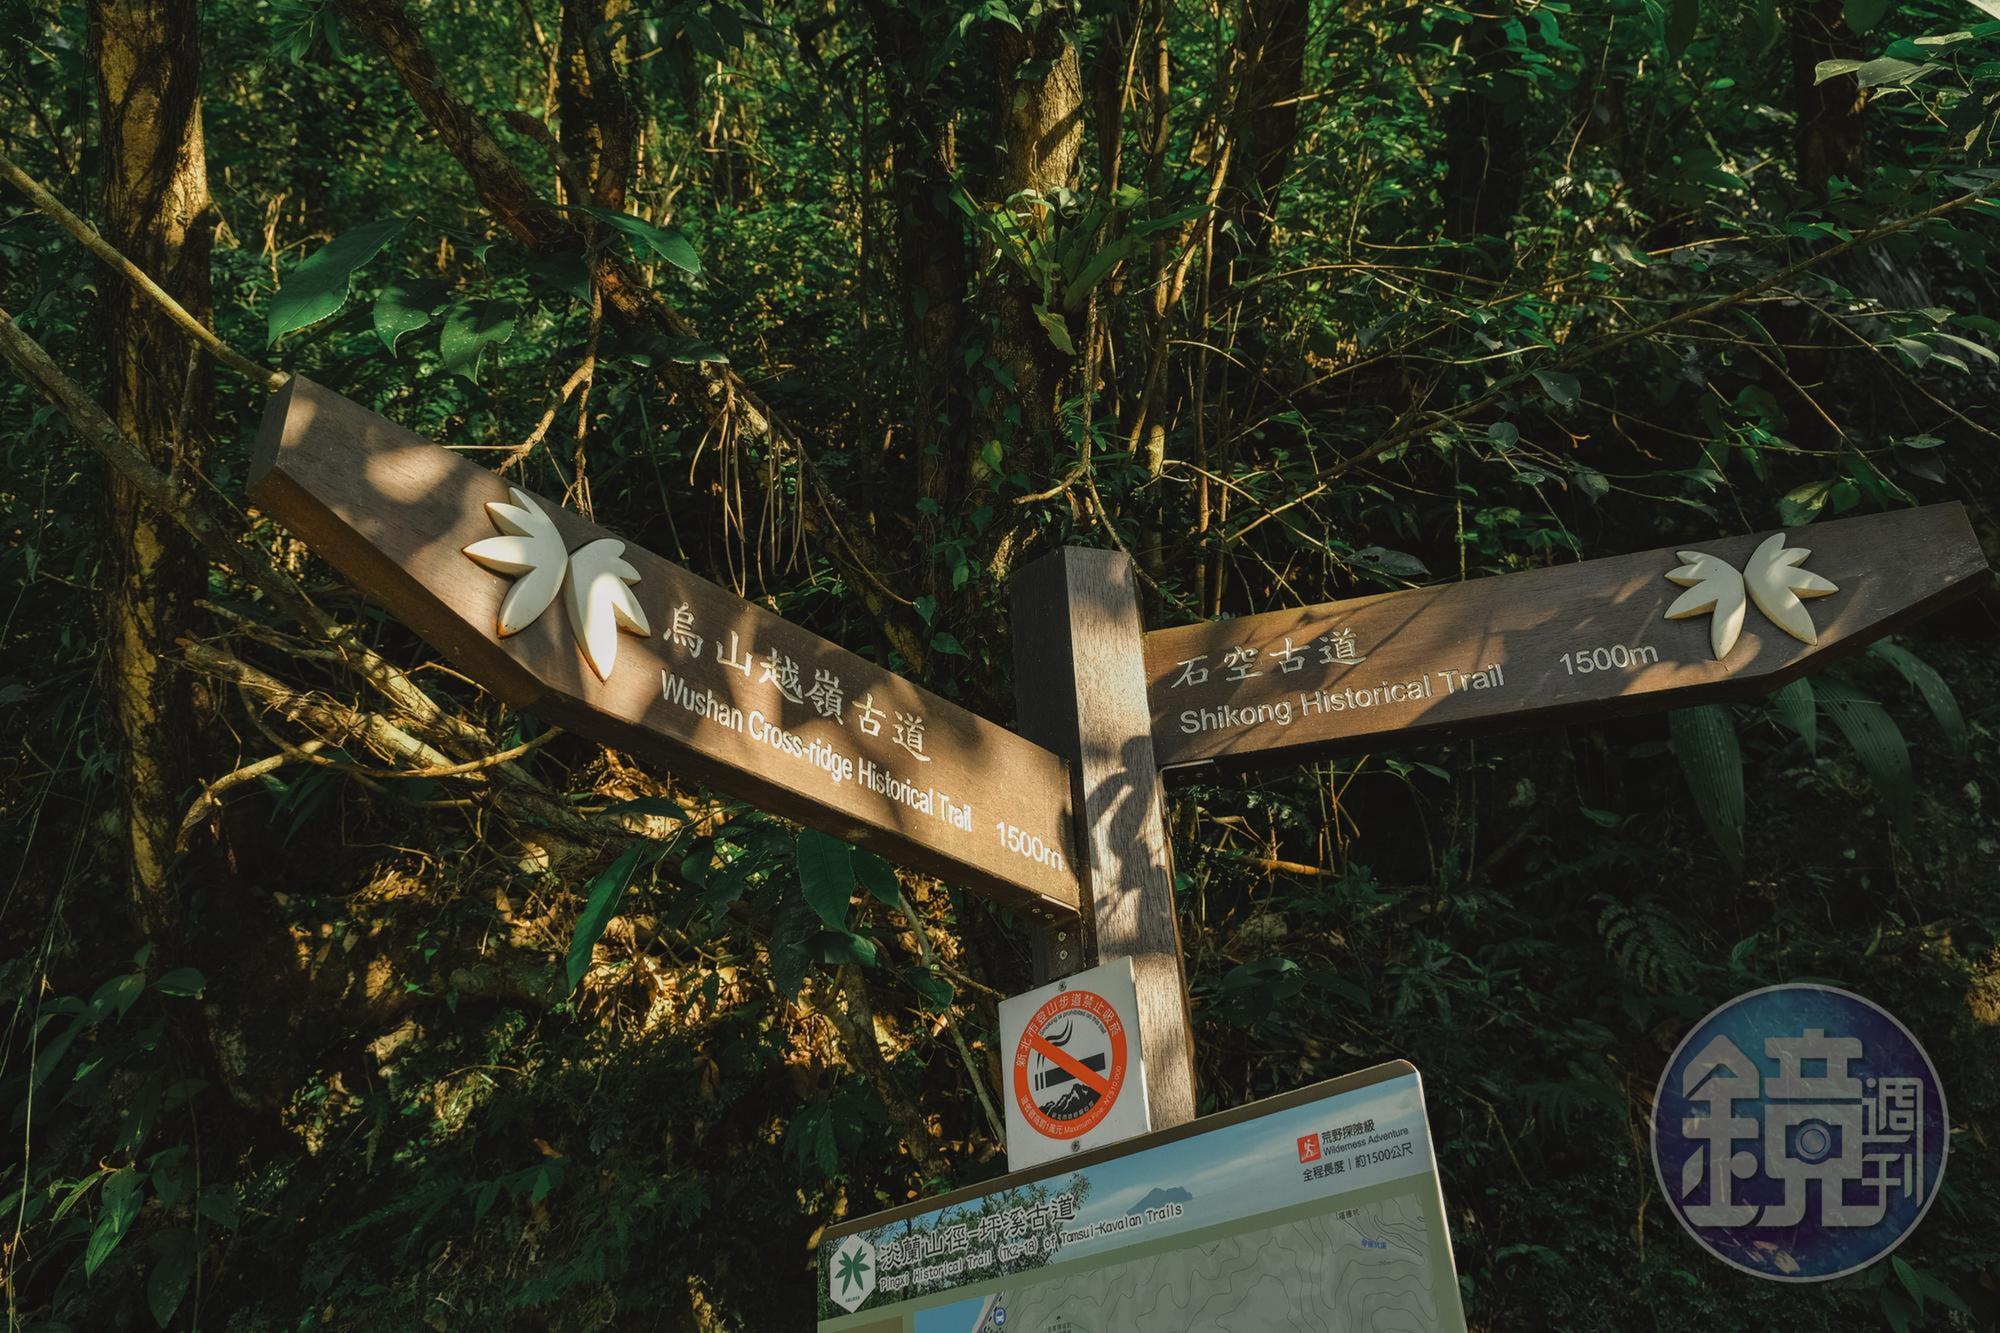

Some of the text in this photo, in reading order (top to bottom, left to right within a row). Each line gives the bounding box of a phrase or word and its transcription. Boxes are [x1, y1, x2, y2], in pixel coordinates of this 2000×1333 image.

[663, 601, 932, 763] 烏山越嶺古道
[1170, 627, 1367, 690] 石空古道
[1179, 643, 1659, 736] Shikong Historical Trail 1500m
[660, 668, 1063, 872] Wushan Cross-ridge Historical Trail 1500m
[1064, 1118, 1091, 1134] Maximum
[1321, 1119, 1375, 1145] 荒野探險級
[1323, 1127, 1409, 1156] Wilderness Adventure
[879, 1203, 1184, 1293] Pingxi Historical Trail (TK2-18) of Tamsui-Kavalan Trails
